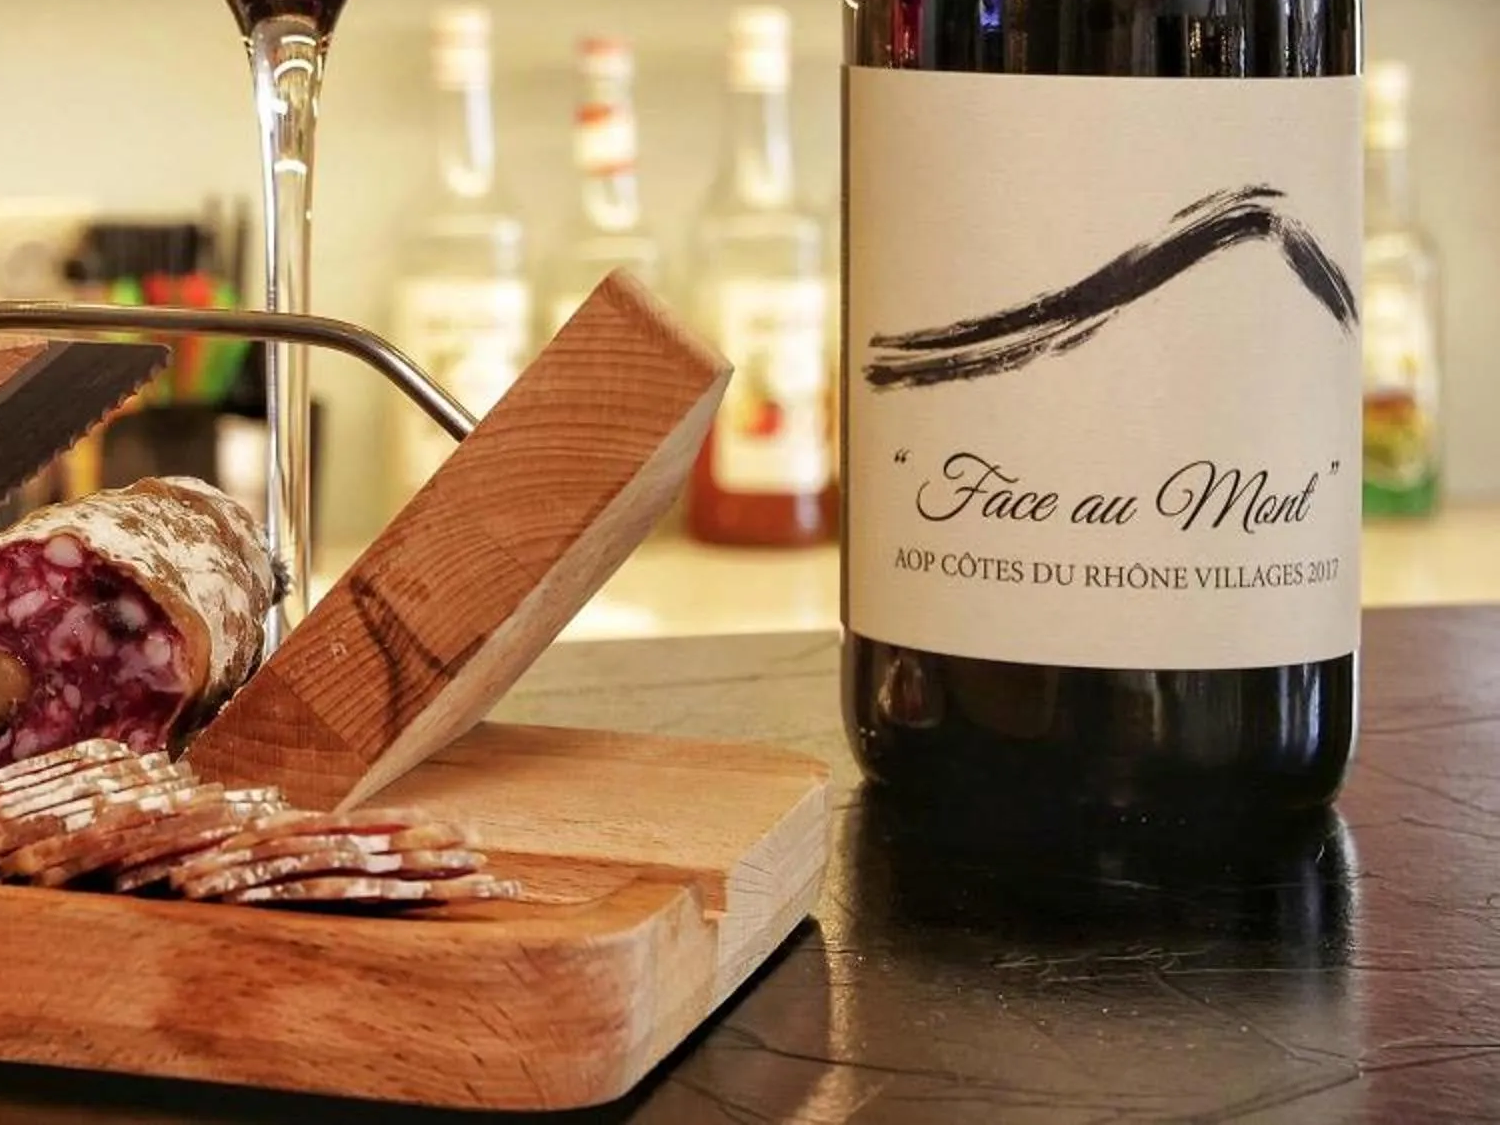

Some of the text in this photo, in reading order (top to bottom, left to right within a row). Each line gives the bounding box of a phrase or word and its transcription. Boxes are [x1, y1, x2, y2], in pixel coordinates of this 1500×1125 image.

[1070, 494, 1138, 525] au
[894, 547, 1339, 589] AOP CÔTES DU RHÔNE VILLAGES 2017
